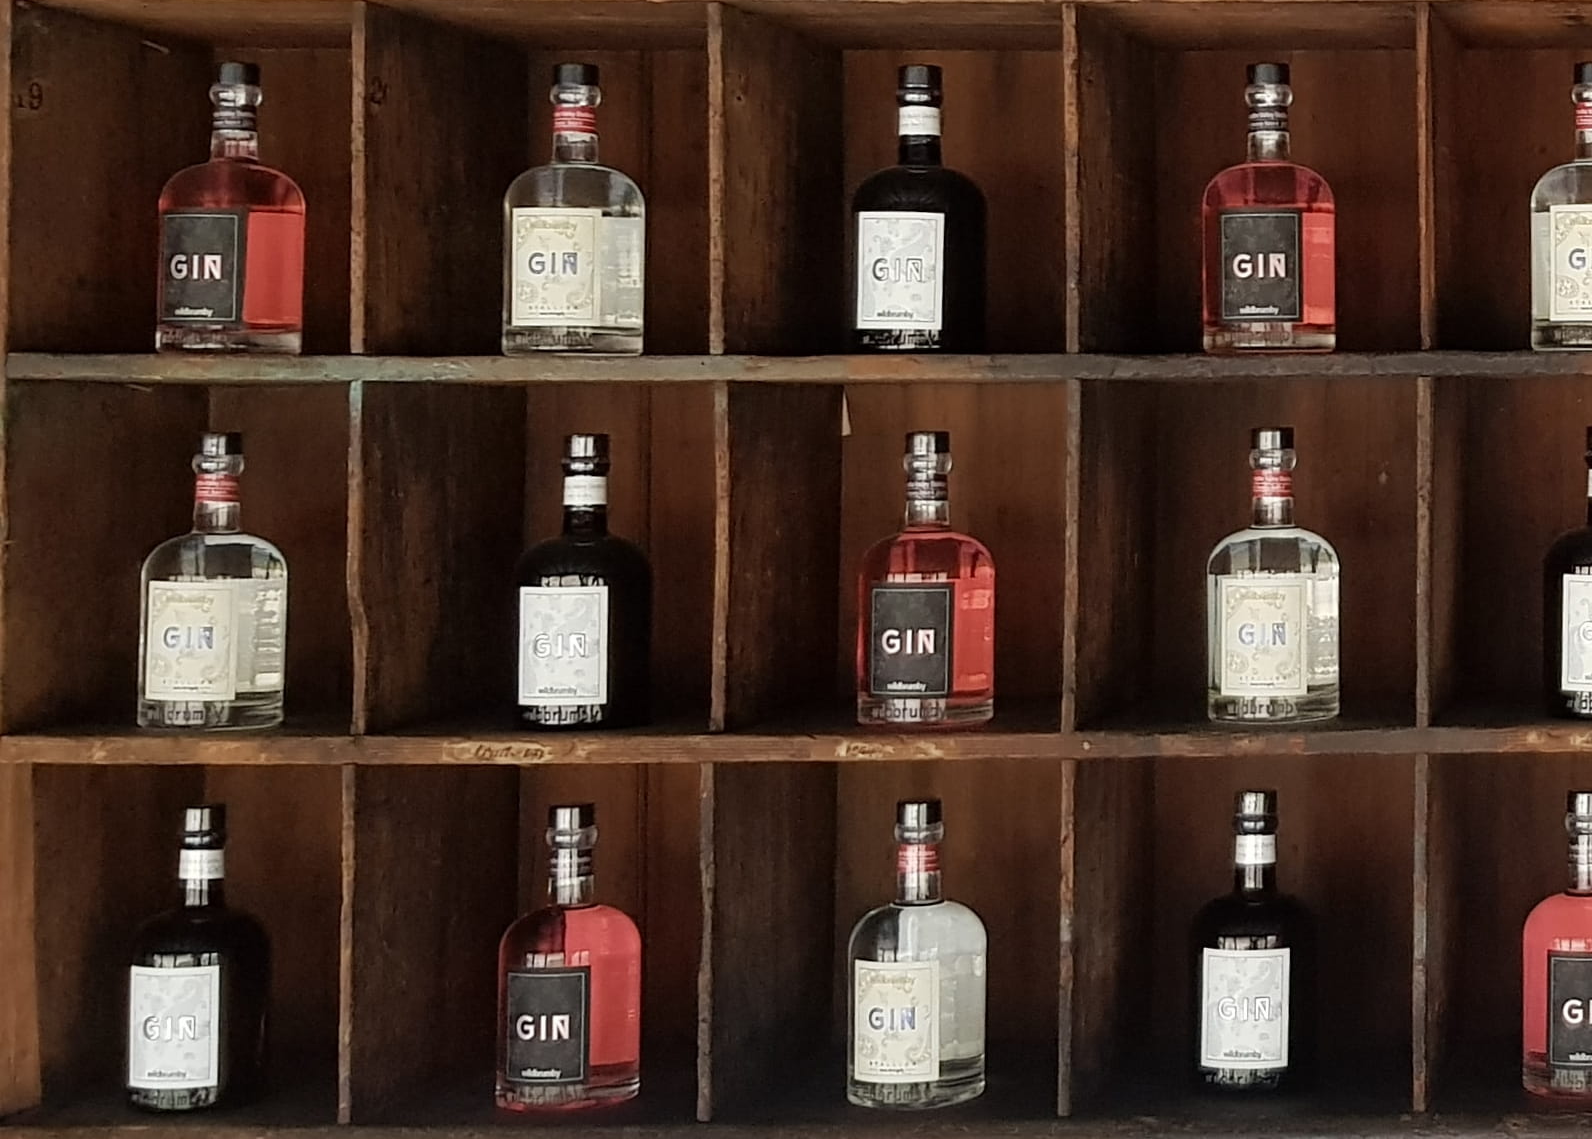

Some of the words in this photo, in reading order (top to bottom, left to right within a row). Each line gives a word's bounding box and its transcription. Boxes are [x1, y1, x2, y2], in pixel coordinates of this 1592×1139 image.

[170, 254, 221, 280] GIN
[528, 252, 578, 275] GIN
[872, 258, 923, 281] GIN
[1233, 253, 1286, 278] GIN
[164, 626, 214, 649] GIN
[534, 633, 586, 658] GIN
[882, 629, 935, 654] GIN
[1238, 623, 1286, 645] GIN
[868, 1007, 916, 1031] GIN
[1218, 997, 1270, 1021] GIN
[143, 1015, 196, 1040] GIN
[516, 1015, 570, 1040] GIN
